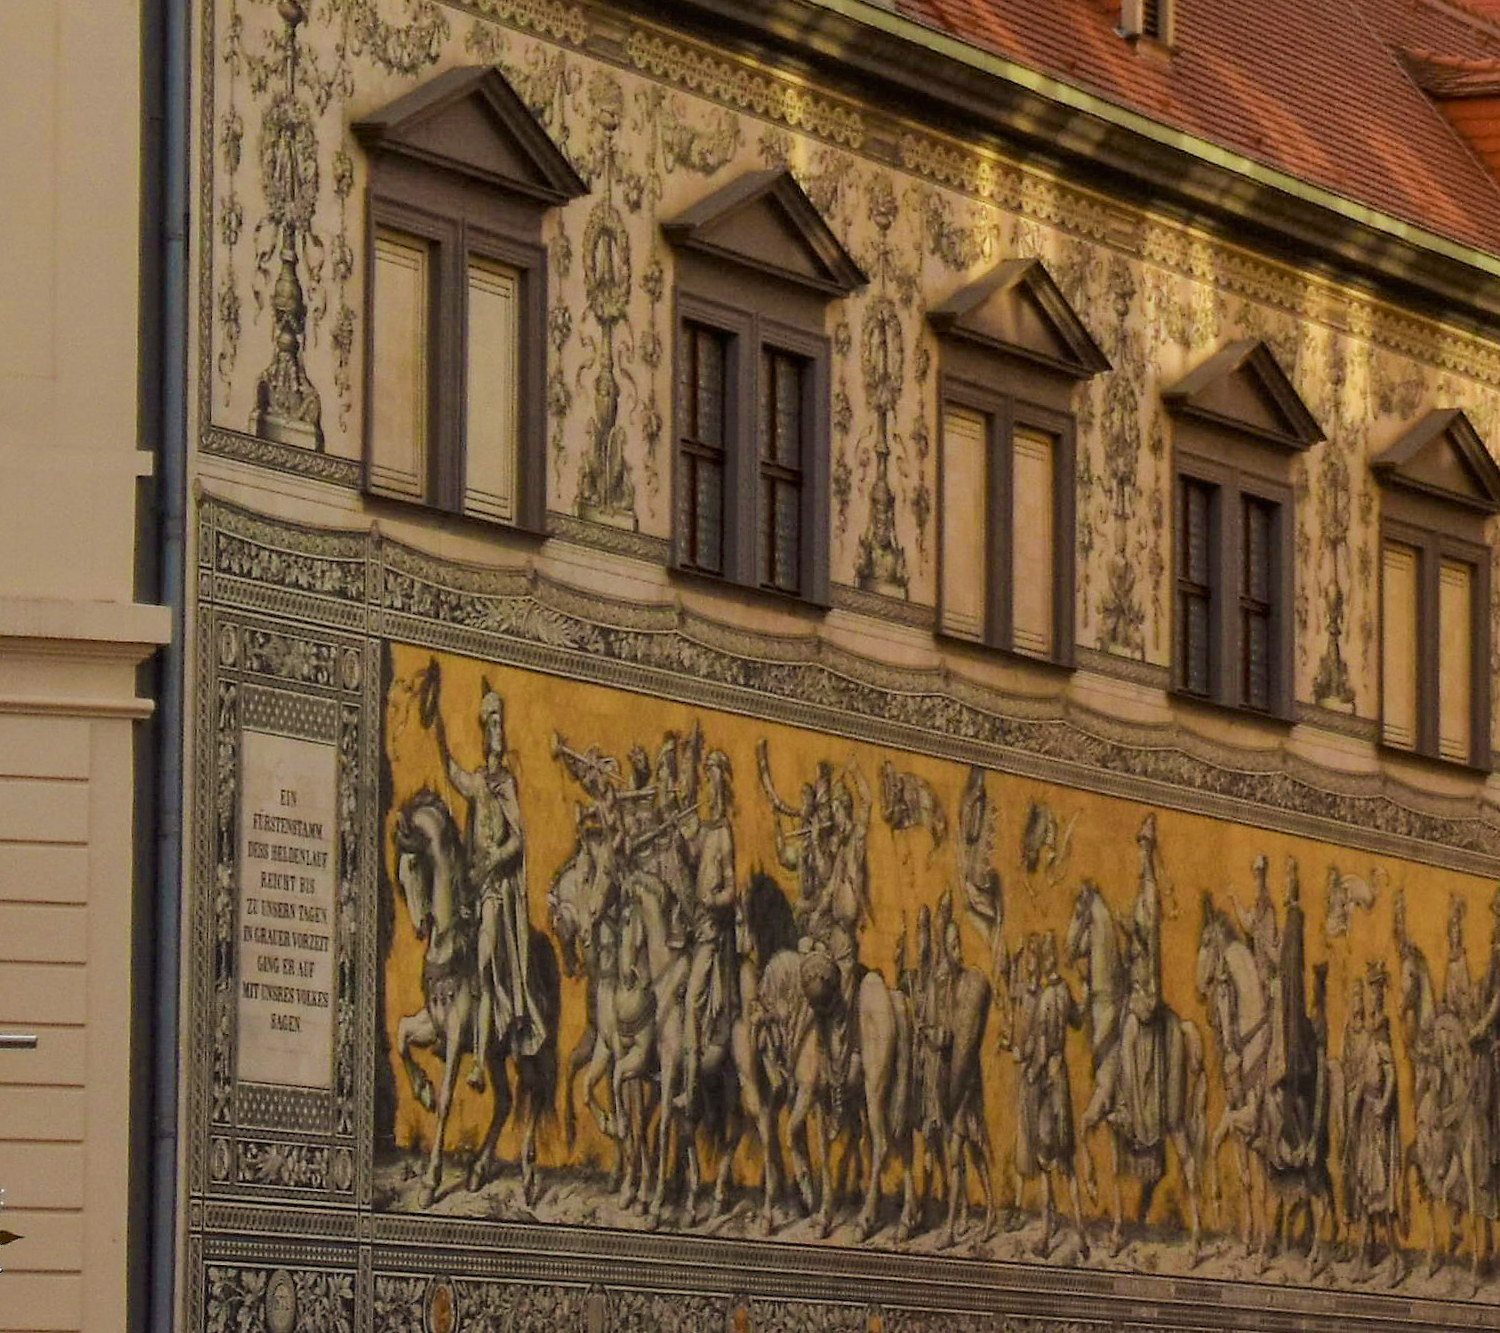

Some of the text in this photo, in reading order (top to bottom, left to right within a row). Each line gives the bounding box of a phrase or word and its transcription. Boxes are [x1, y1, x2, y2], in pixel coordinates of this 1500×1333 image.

[280, 788, 297, 806] EIN
[247, 840, 328, 868] DESS HELDENLAUF
[261, 871, 315, 894] REICHT BIS
[246, 898, 328, 924] ZU UNSERN TAGEN
[243, 925, 329, 952] IN GRAUER VORZEIT
[257, 955, 315, 978] GING ER AUF
[242, 981, 329, 1008] MIT UNSRES VOLKES
[270, 1013, 301, 1033] SAGEN
